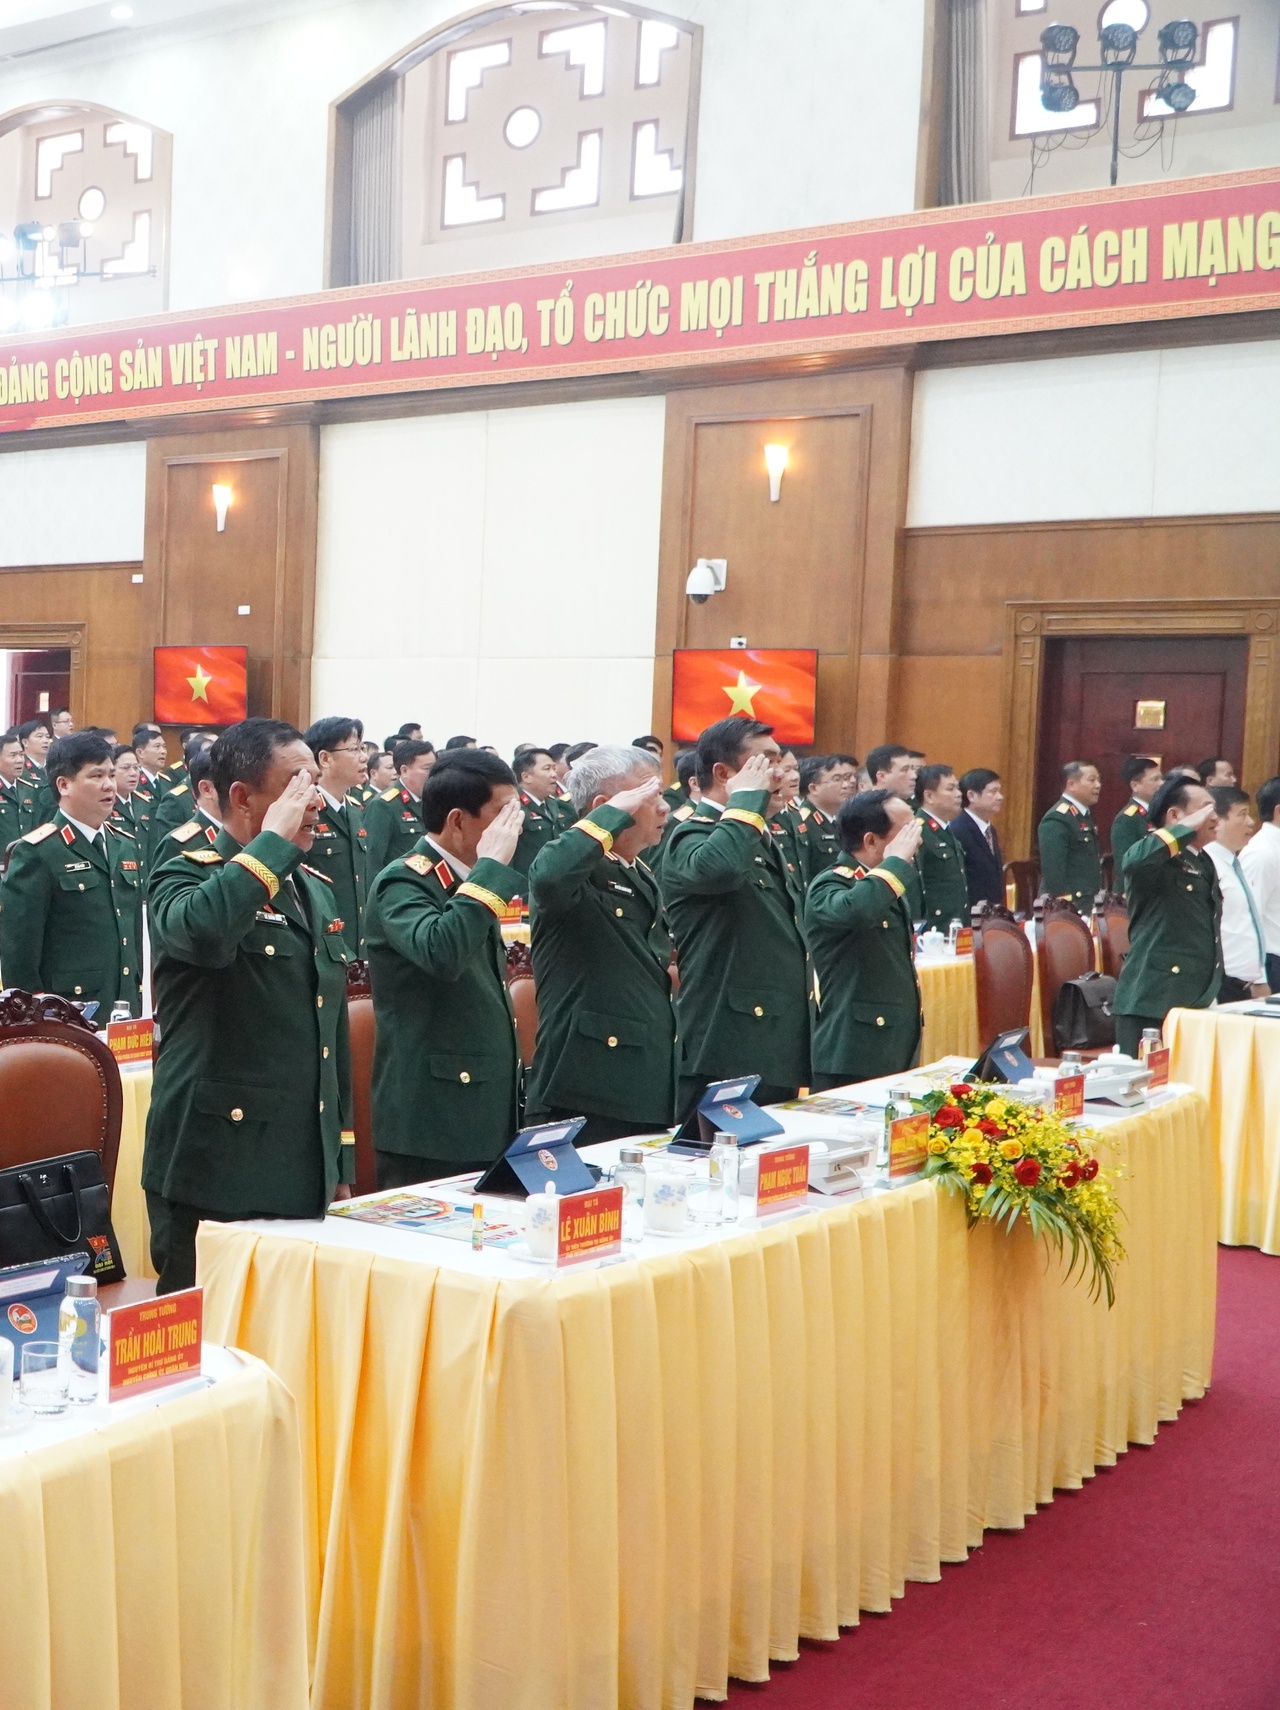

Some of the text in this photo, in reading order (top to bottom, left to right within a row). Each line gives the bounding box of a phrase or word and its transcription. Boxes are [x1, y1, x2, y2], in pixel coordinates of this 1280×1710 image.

[55, 350, 113, 405] CỘNG
[120, 338, 163, 392] SẢN
[169, 333, 218, 391] VIỆT
[226, 331, 279, 380] NAM
[302, 312, 382, 372] NGƯỜI
[390, 307, 457, 362] LÃNH
[465, 302, 529, 361] ĐẠO,
[536, 279, 575, 347] TỔ
[584, 279, 670, 343] CHỨC
[680, 275, 744, 338] MỌI
[754, 250, 869, 323] THẮNG
[880, 244, 937, 317] LỢI
[948, 231, 1027, 302] CỦA
[1039, 225, 1148, 293] CÁCH
[1162, 211, 1280, 287] MẠNG
[561, 1207, 619, 1242] LÊ XUÂN BÌNH
[159, 1303, 177, 1317] TƯỚNG
[115, 1319, 197, 1366] TRẦN HOÀI TRUNG
